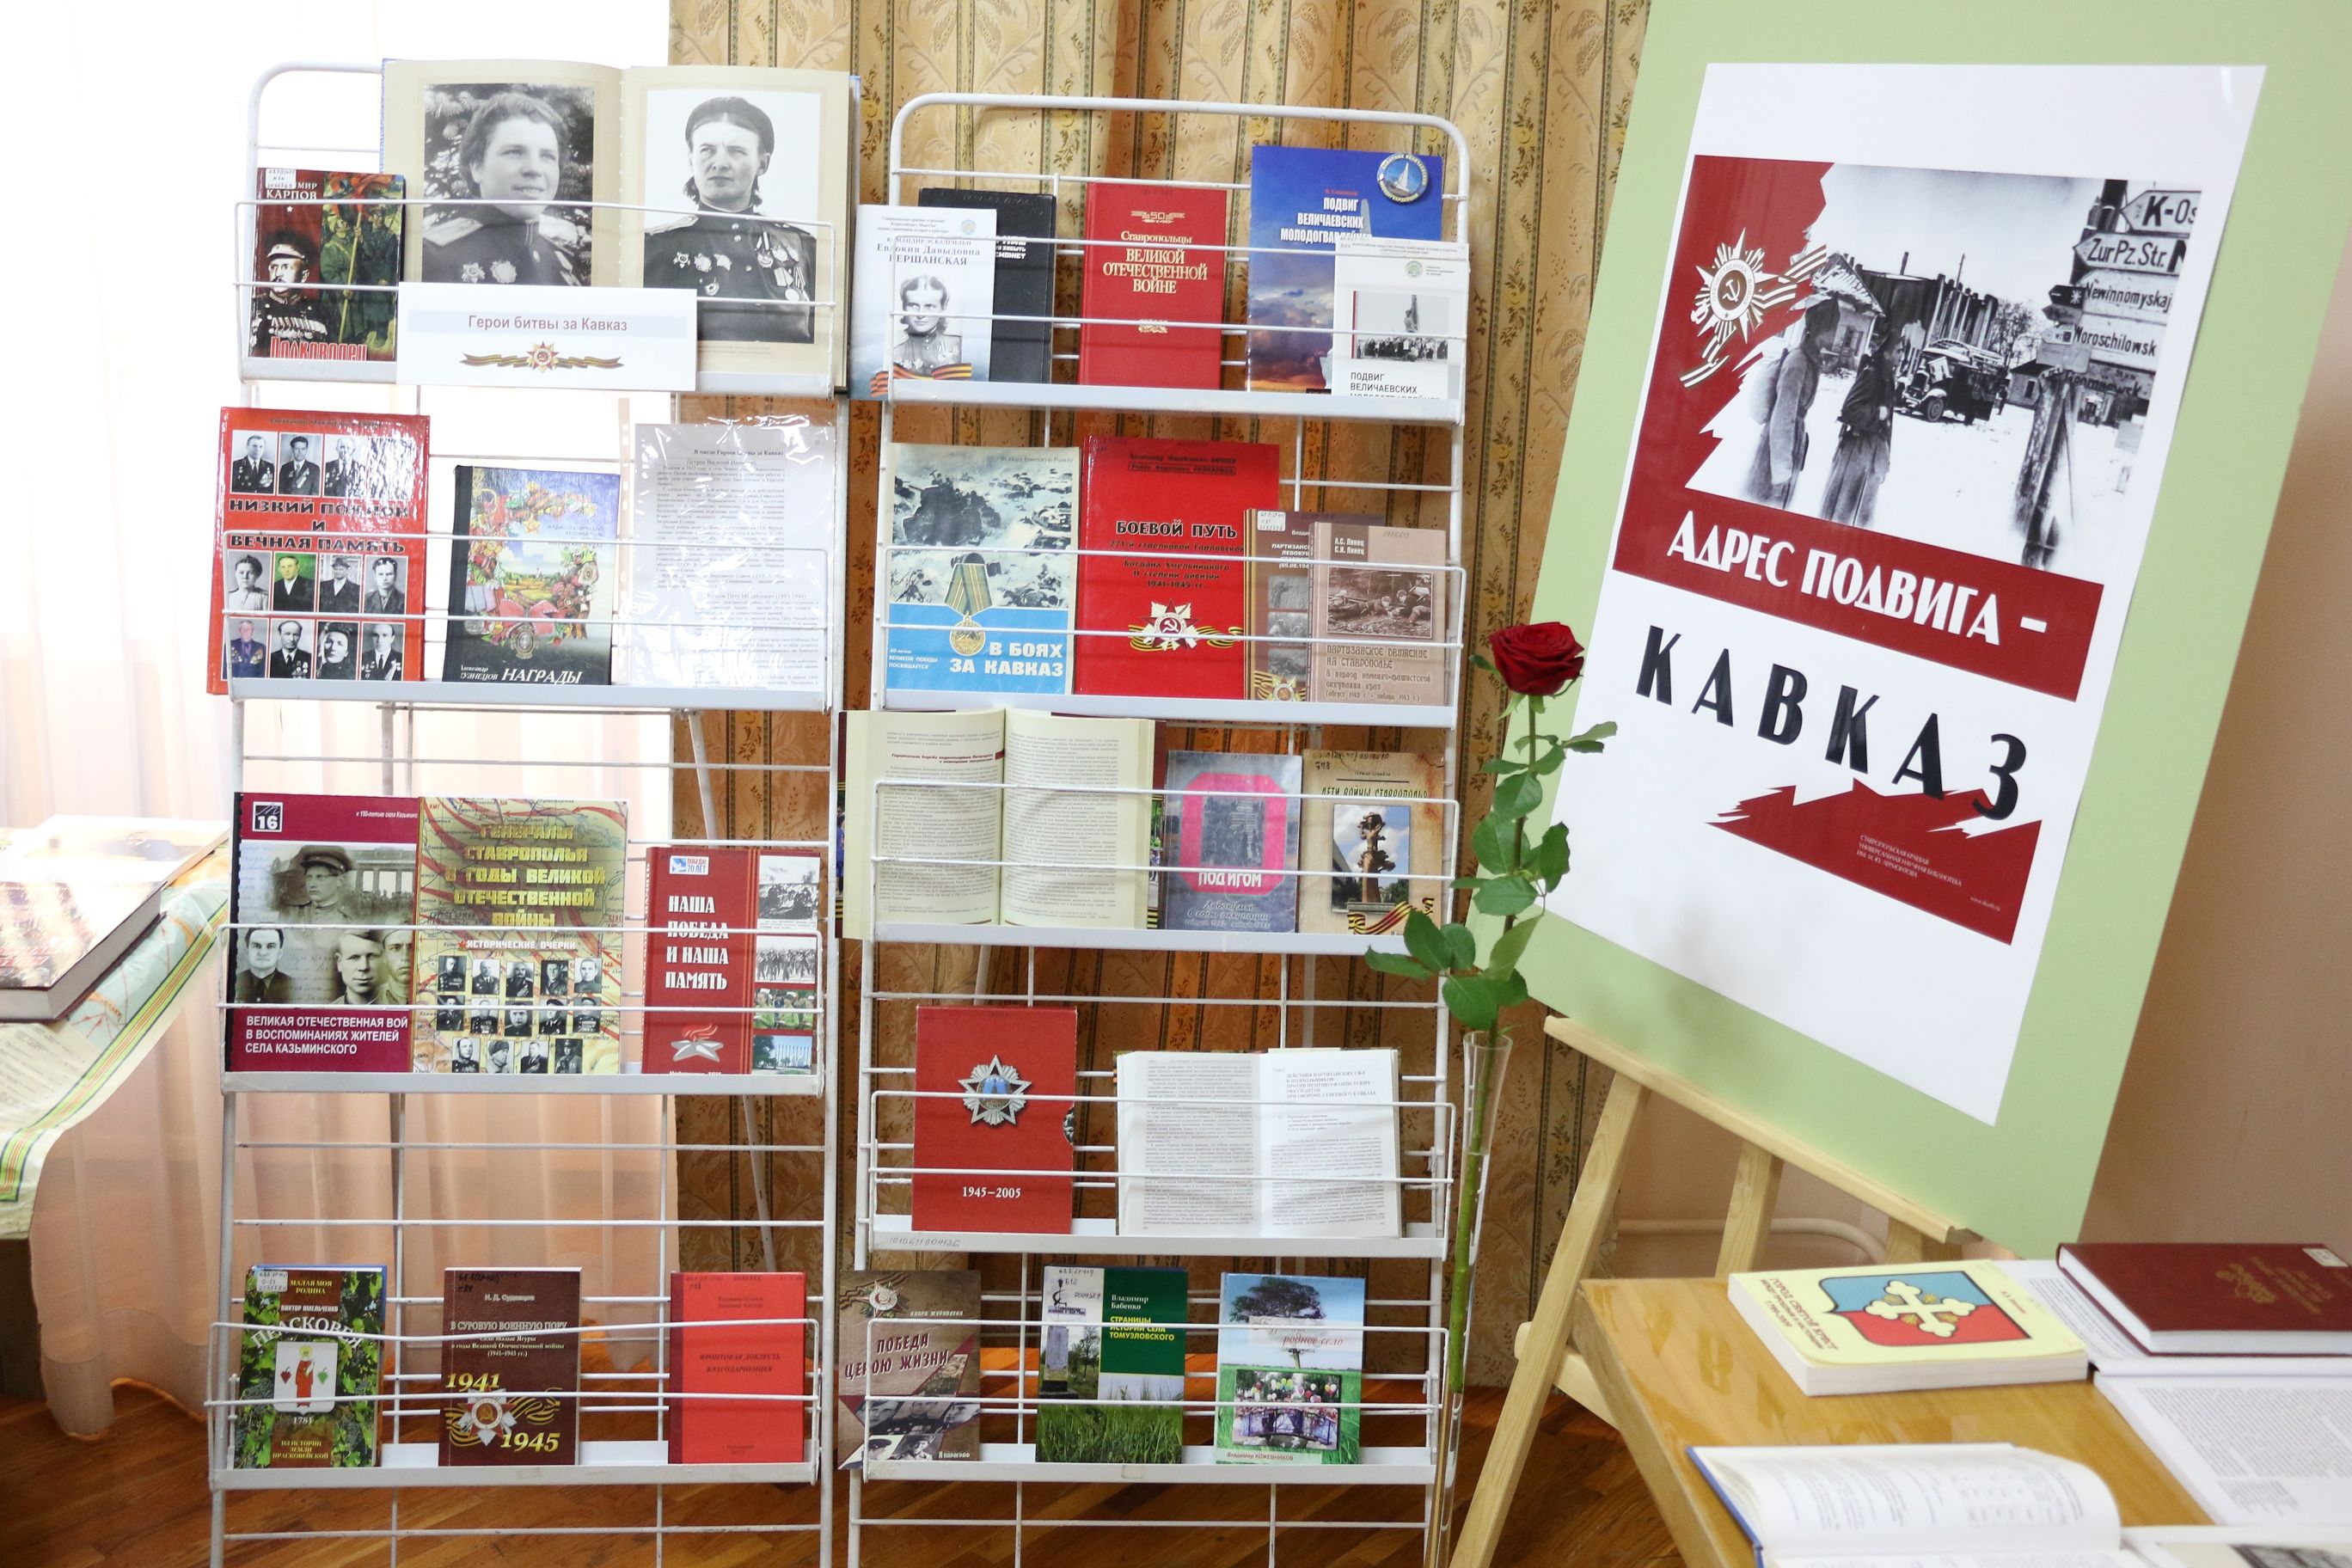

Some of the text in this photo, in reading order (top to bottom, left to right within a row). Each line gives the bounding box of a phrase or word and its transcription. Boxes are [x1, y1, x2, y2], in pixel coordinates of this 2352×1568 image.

[266, 190, 317, 199] КАРПОВ
[1323, 198, 1358, 212] ПОДВИГ
[1297, 212, 1364, 229] ВЕЛИЧАЕВСКИХ
[1120, 230, 1192, 244] Ставропольцы
[922, 244, 981, 256] Давыдовна
[1125, 248, 1185, 265] ВЕЛИКОЙ
[2087, 238, 2115, 262] Zur
[2137, 242, 2167, 268] Str.
[1103, 261, 1208, 280] ОТЕЧЕСТВЕННОЙ
[1133, 277, 1177, 294] ВОЙНЕ
[468, 315, 628, 332] Герои битвы за Кавказ
[2073, 324, 2157, 357] Woroschilowsk
[1351, 372, 1385, 382] ПОДВИГ
[1351, 383, 1418, 395] ВЕЛИЧАЕВСКИХ
[230, 498, 315, 514] НИЗКИЙ
[312, 520, 326, 531] И
[1116, 519, 1238, 539] БОЕВОЙ ПУТЬ
[230, 535, 406, 553] ВЕЧНАЯ ПАМЯТЬ
[1138, 542, 1190, 551] стрелковой
[1334, 537, 1345, 546] А.С.
[1124, 560, 1229, 571] Богдана Хмельницкого
[1666, 510, 1795, 587] АДРЕС
[1801, 548, 2000, 645] ПОДВИГА
[989, 641, 1063, 658] В БОЯХ
[1326, 645, 1383, 657] ПАРТИЗАНСКОЕ
[949, 658, 1063, 677] ЗА КАВКАЗ
[1326, 657, 1393, 669] НА СТАВРОПОЛЬЕ
[501, 668, 583, 685] НАГРАДЫ
[1635, 625, 2027, 821] КАВКАЗ
[1344, 786, 1371, 797] ВОЙНЫ
[257, 816, 279, 830] 16
[480, 824, 573, 840] ГЕНЕРАЛЫ
[465, 846, 588, 862] СТАВРОПОЛЬЯ
[445, 867, 605, 885] В ГОДЫ ВЕЛИКОЙ
[687, 864, 695, 873] 70
[1198, 872, 1262, 888] ПОД ИГОМ
[454, 887, 595, 906] ОТЕЧЕСТВЕННОЙ
[668, 895, 715, 913] НАША
[492, 909, 555, 927] ВОЙНЫ
[667, 920, 729, 940] ПОБЕДА
[467, 940, 576, 950] ИСТОРИЧЕСКИЕ ОЧЕРКИ
[666, 946, 729, 965] И НАША
[665, 971, 727, 990] ПАМЯТЬ
[247, 1016, 408, 1028] ВЕЛИКАЯ ОТЕЧЕСТВЕННАЯ ВОЙ
[246, 1029, 400, 1042] В ВОСПОМИНАНИЯХ ЖИТЕЛЕЙ
[245, 1043, 358, 1055] СЕЛА КАЗЬМИНСКОГО
[1112, 1294, 1149, 1304] Владимир
[450, 1321, 456, 1331] В
[457, 1321, 498, 1331] СУРОВУЮ
[499, 1321, 543, 1330] ВОЕННУЮ
[877, 1332, 930, 1355] ПОБЕДА
[1109, 1332, 1175, 1341] ТОМУЗЛОВСКОГО
[1282, 1332, 1344, 1347] родное село
[899, 1349, 949, 1372] ЖИЗНИ
[445, 1373, 501, 1392] 1941
[500, 1432, 561, 1453] 1945
